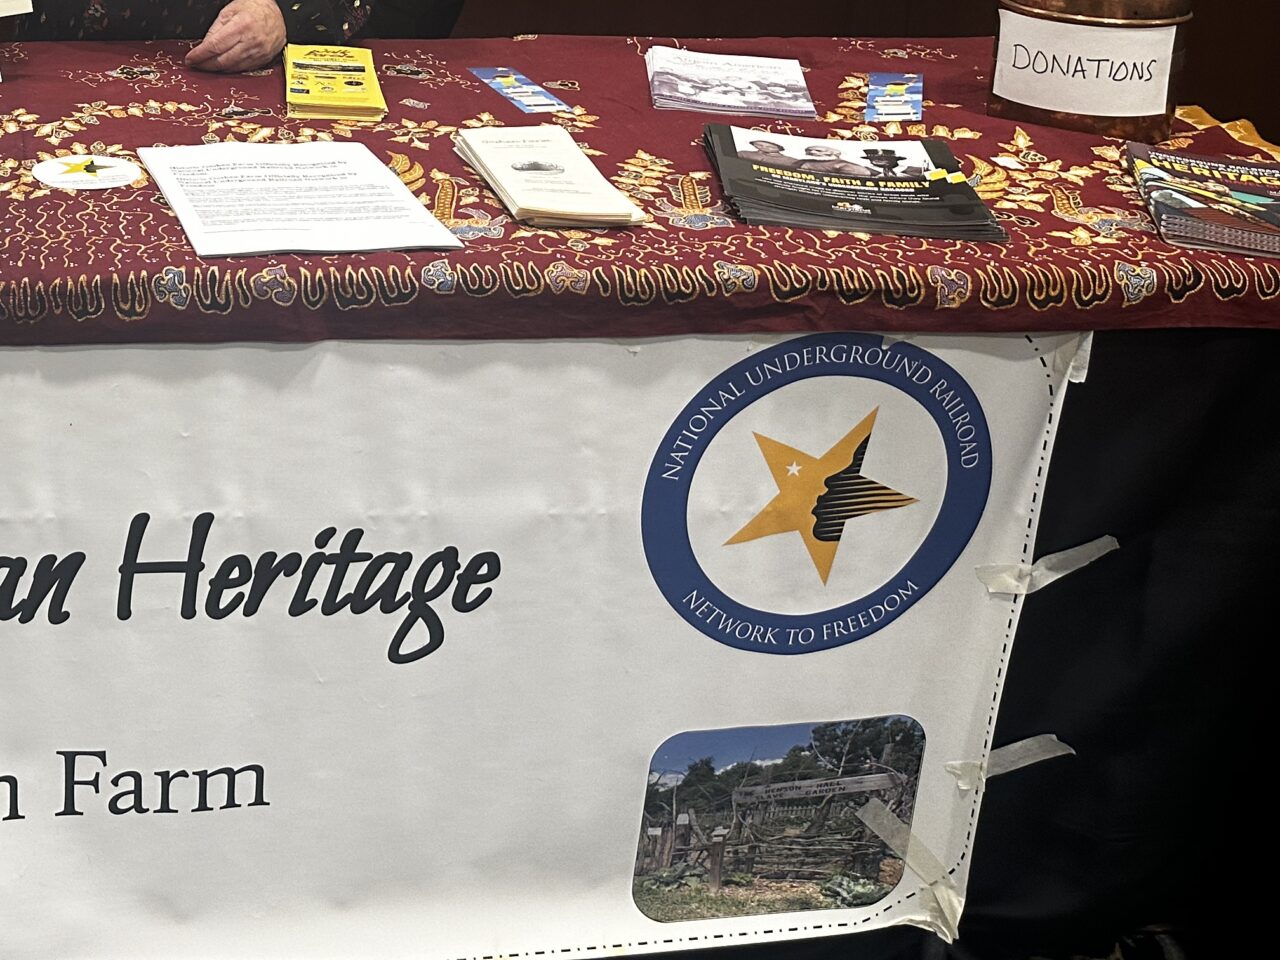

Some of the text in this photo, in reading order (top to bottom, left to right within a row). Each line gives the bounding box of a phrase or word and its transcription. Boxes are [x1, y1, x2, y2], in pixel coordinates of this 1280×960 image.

[1012, 44, 1157, 82] DONATIONS
[752, 164, 820, 182] FREEDOM,
[823, 176, 861, 186] FAITH
[1150, 158, 1280, 185] HERITAG
[662, 344, 979, 481] NATIONAL UNDERGROUND RAILROAD
[117, 513, 501, 664] Heritage
[682, 579, 919, 646] NETWORK TO FREEDOM
[55, 751, 270, 816] Farm
[804, 786, 846, 796] GARDEN
